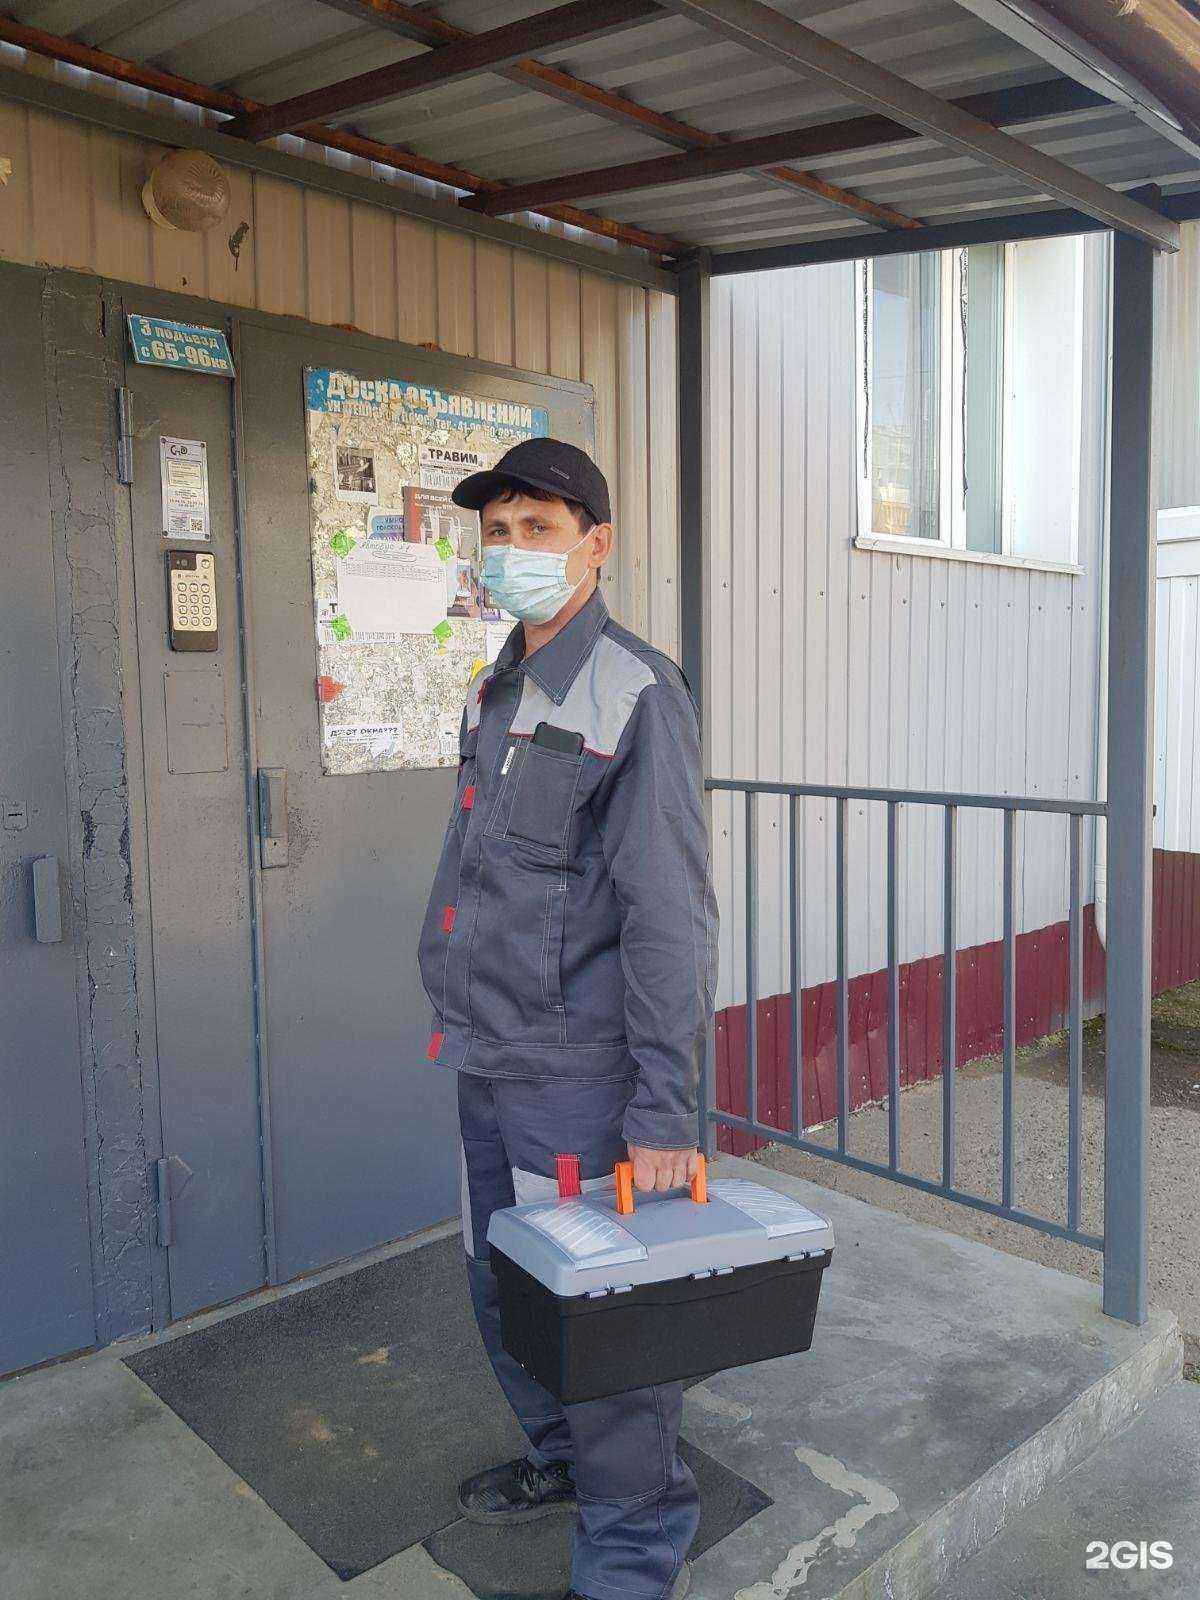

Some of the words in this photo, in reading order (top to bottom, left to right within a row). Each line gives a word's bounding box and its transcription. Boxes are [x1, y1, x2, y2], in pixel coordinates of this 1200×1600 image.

[140, 319, 152, 336] 3
[327, 371, 403, 404] ДОСКА
[428, 448, 479, 465] ТРАВИМ
